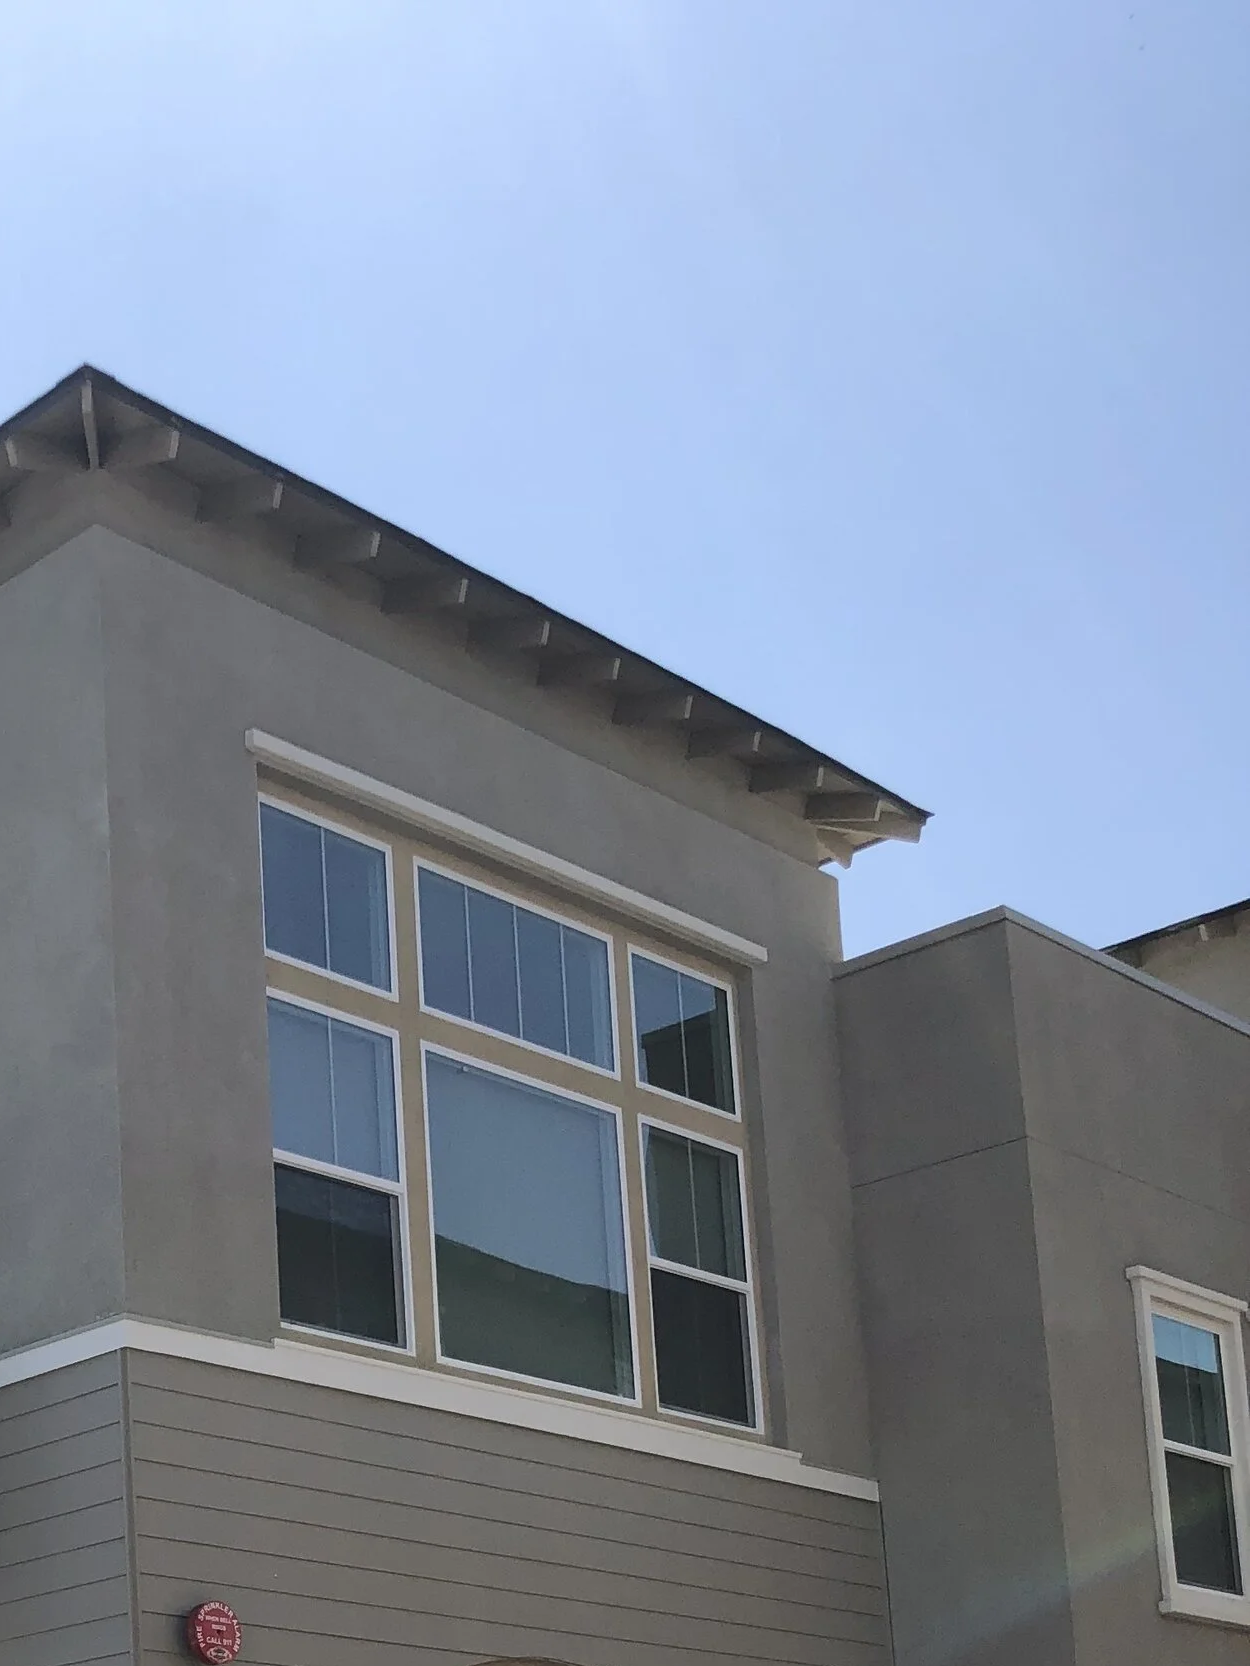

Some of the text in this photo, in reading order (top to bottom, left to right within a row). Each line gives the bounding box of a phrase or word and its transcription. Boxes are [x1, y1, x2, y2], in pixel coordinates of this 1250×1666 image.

[196, 1602, 241, 1652] FIRE SPRINKLER ALARM
[206, 1637, 232, 1646] CALL 911
